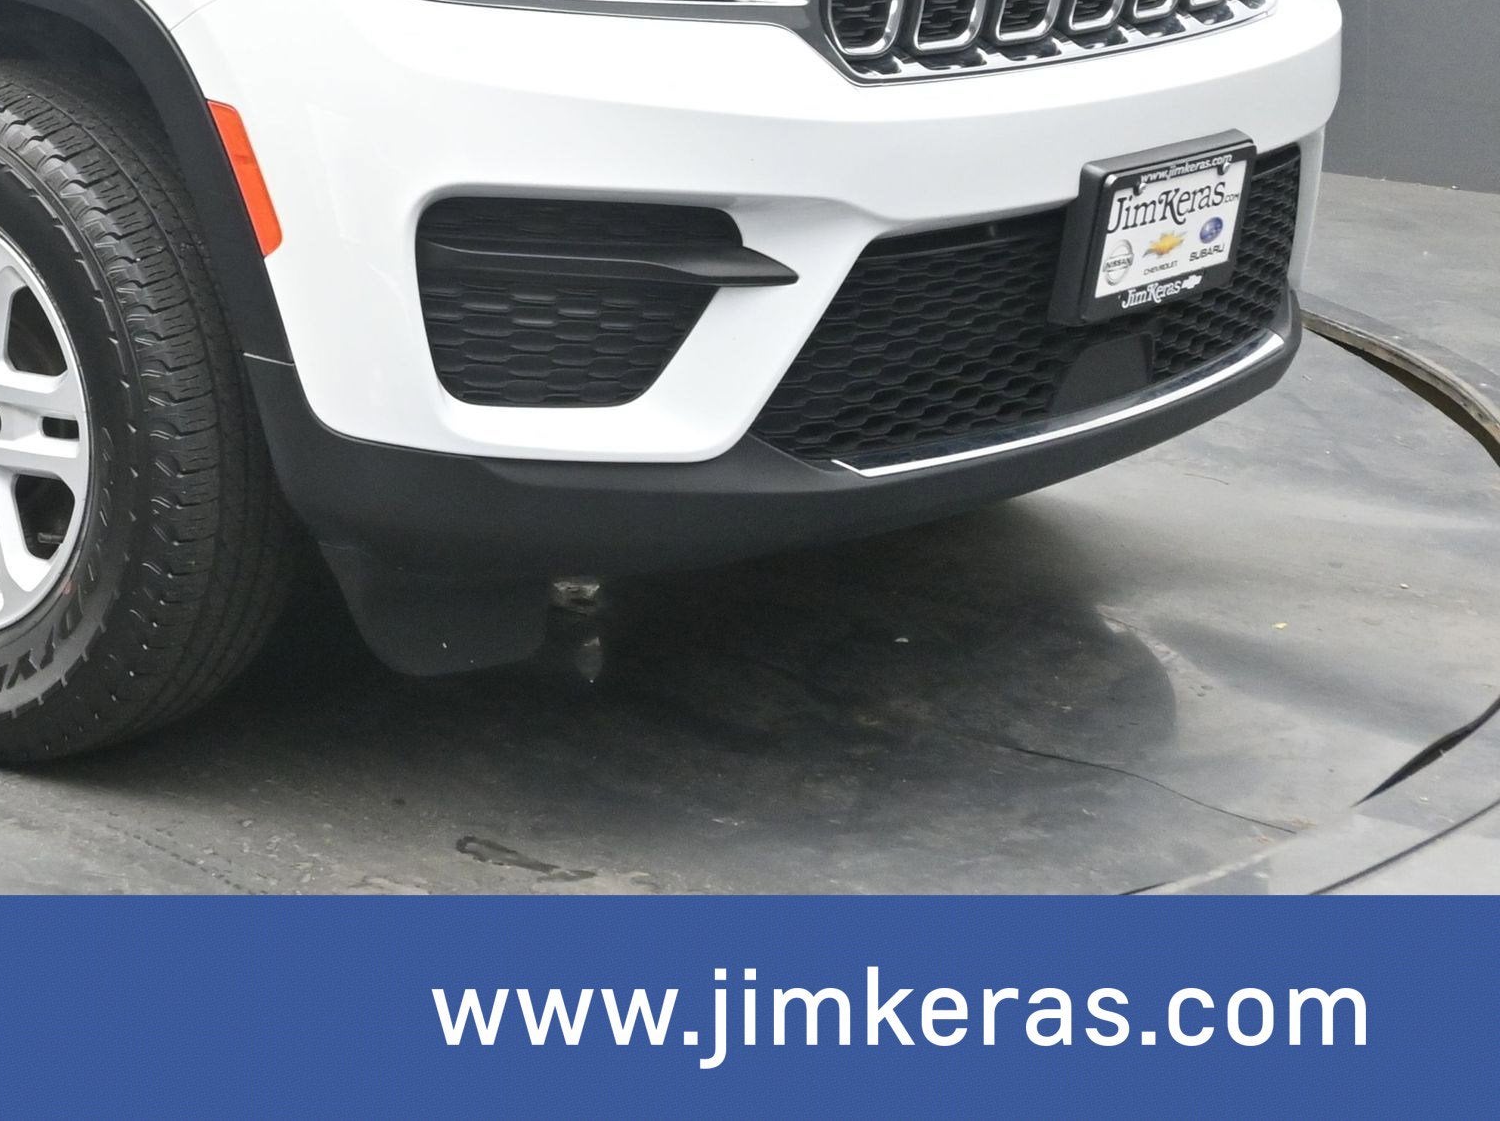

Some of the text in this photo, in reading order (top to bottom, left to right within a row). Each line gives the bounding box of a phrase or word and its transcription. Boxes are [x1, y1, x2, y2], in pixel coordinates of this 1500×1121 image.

[1140, 154, 1233, 184] www.jimkeras.com
[1189, 244, 1225, 261] SUBARU
[1105, 257, 1132, 269] NISSAN
[1143, 260, 1178, 276] CHEVROLET
